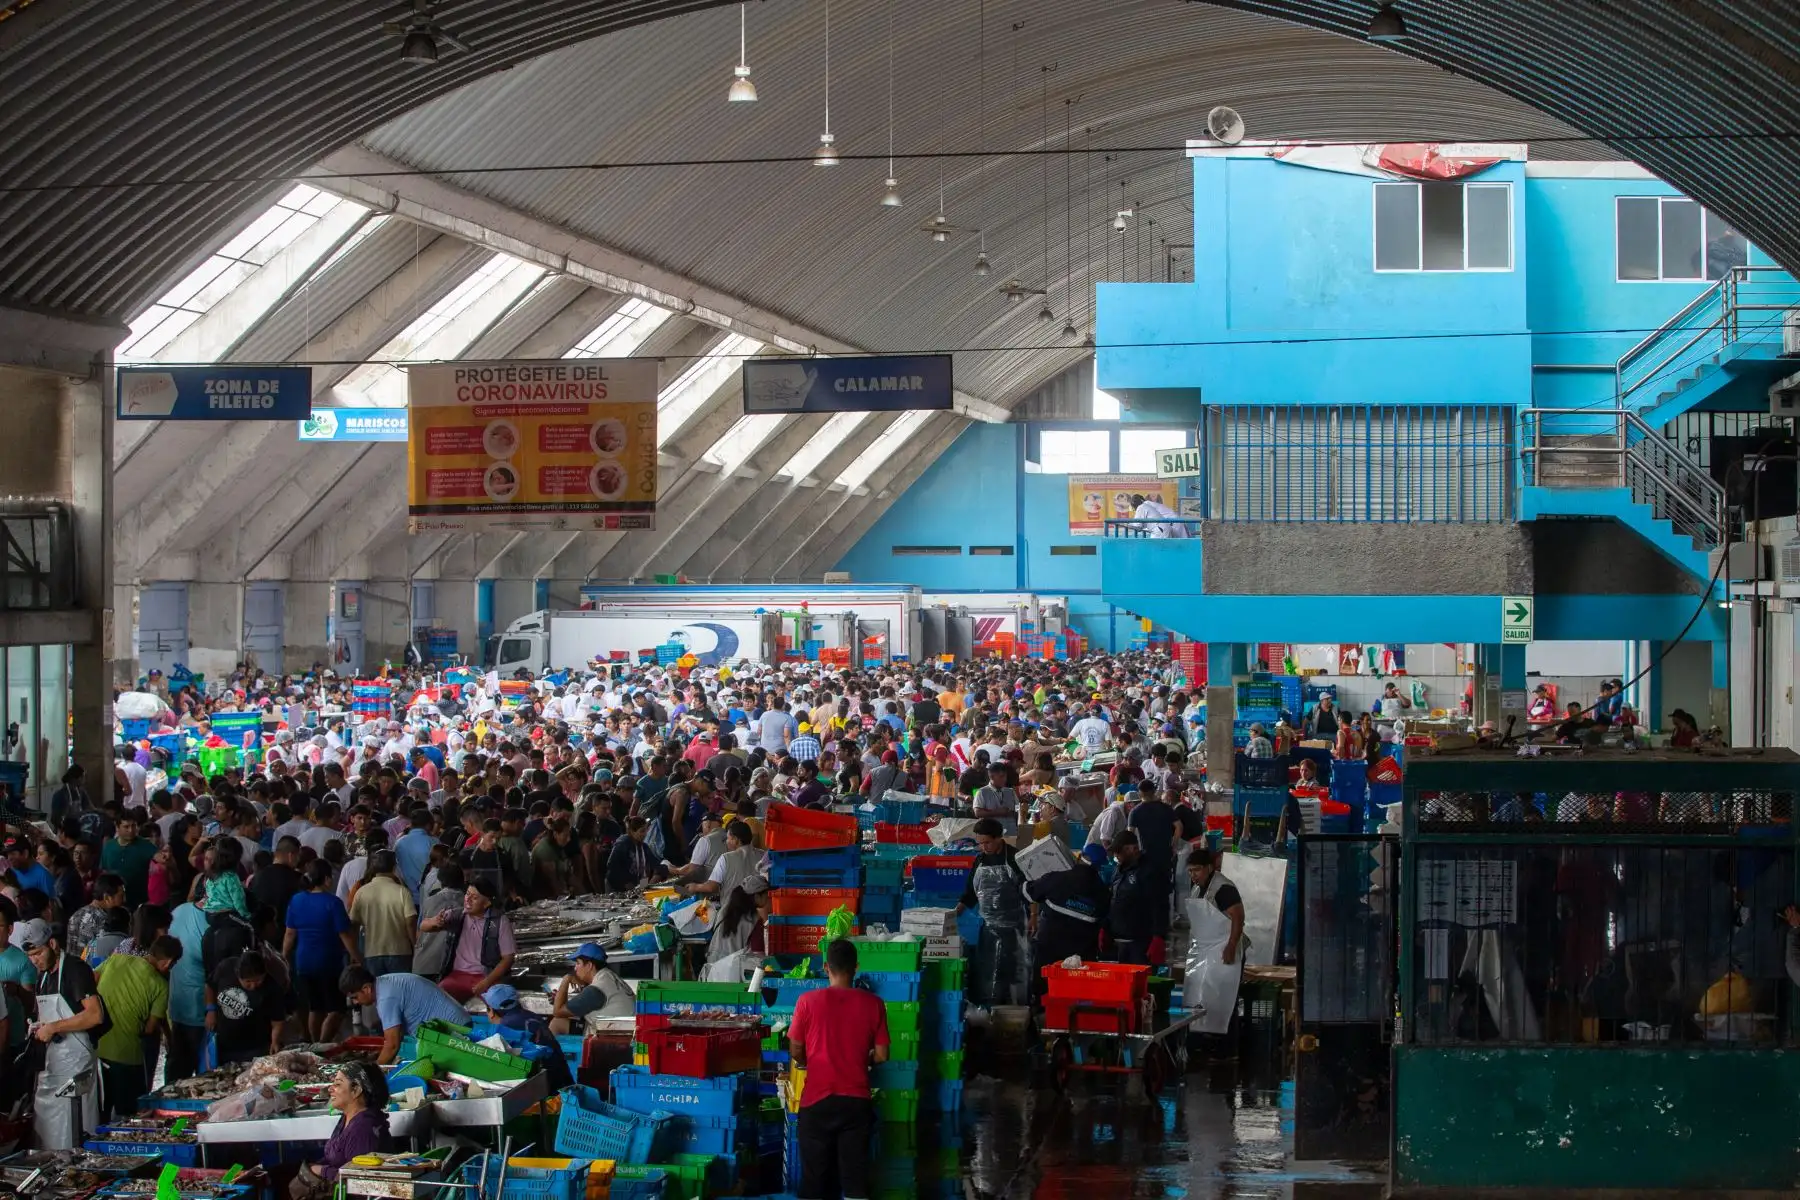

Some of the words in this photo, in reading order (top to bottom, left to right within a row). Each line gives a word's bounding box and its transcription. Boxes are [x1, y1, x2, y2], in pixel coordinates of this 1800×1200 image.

[455, 364, 566, 384] PROTÉGETE
[572, 366, 608, 381] DEL
[204, 379, 253, 394] ZONA
[257, 379, 280, 394] DE
[834, 376, 923, 392] CALAMAR
[457, 382, 608, 402] CORONAVIRUS
[209, 394, 275, 409] FILETEO
[346, 417, 406, 428] MARISCOS
[1505, 630, 1530, 639] SALIDA
[448, 1038, 501, 1063] PAMELA
